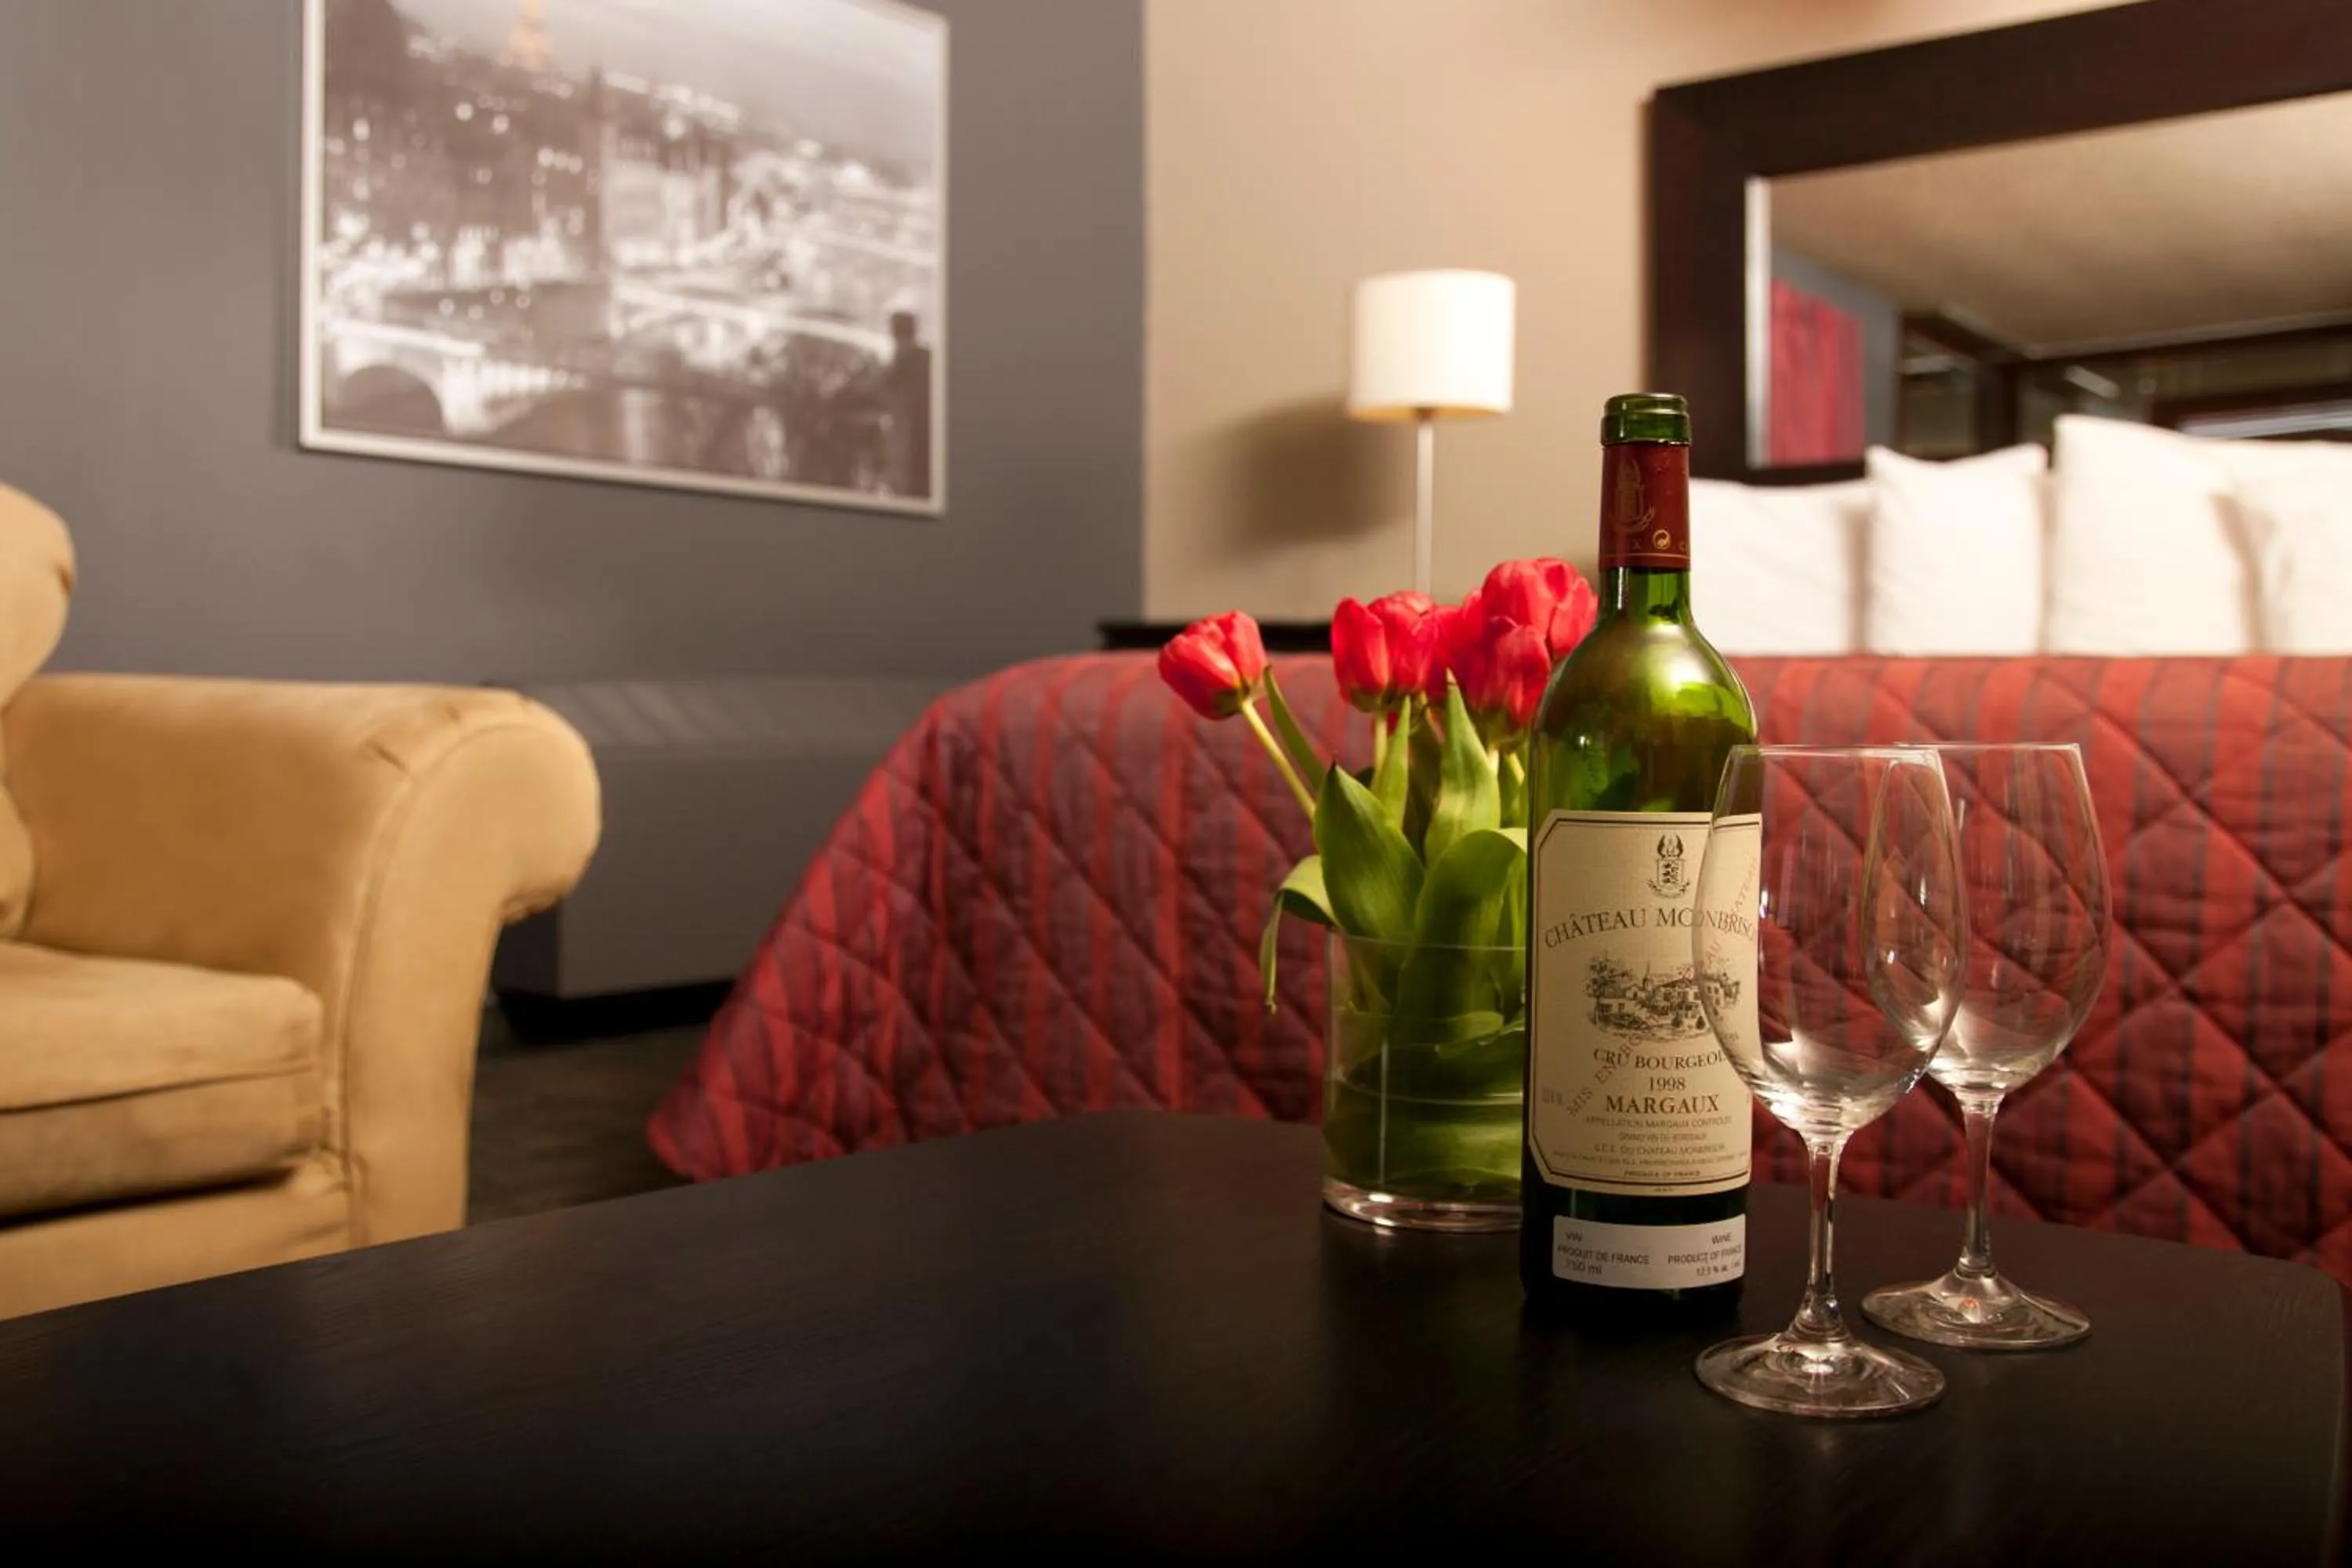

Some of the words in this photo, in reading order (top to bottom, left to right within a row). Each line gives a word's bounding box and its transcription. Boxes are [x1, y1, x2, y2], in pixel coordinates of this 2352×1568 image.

[1544, 907, 1646, 949] CHÂTEAU
[1593, 1048, 1629, 1067] CRU
[1648, 1076, 1686, 1093] 1998
[1605, 1094, 1719, 1115] MARGAUX
[1711, 1232, 1732, 1245] WINE
[1556, 1243, 1592, 1260] PRODUIT
[1596, 1251, 1610, 1262] DE
[1611, 1254, 1650, 1265] FRANCE
[1667, 1252, 1708, 1265] PRODUCT
[1588, 1264, 1602, 1275] ml
